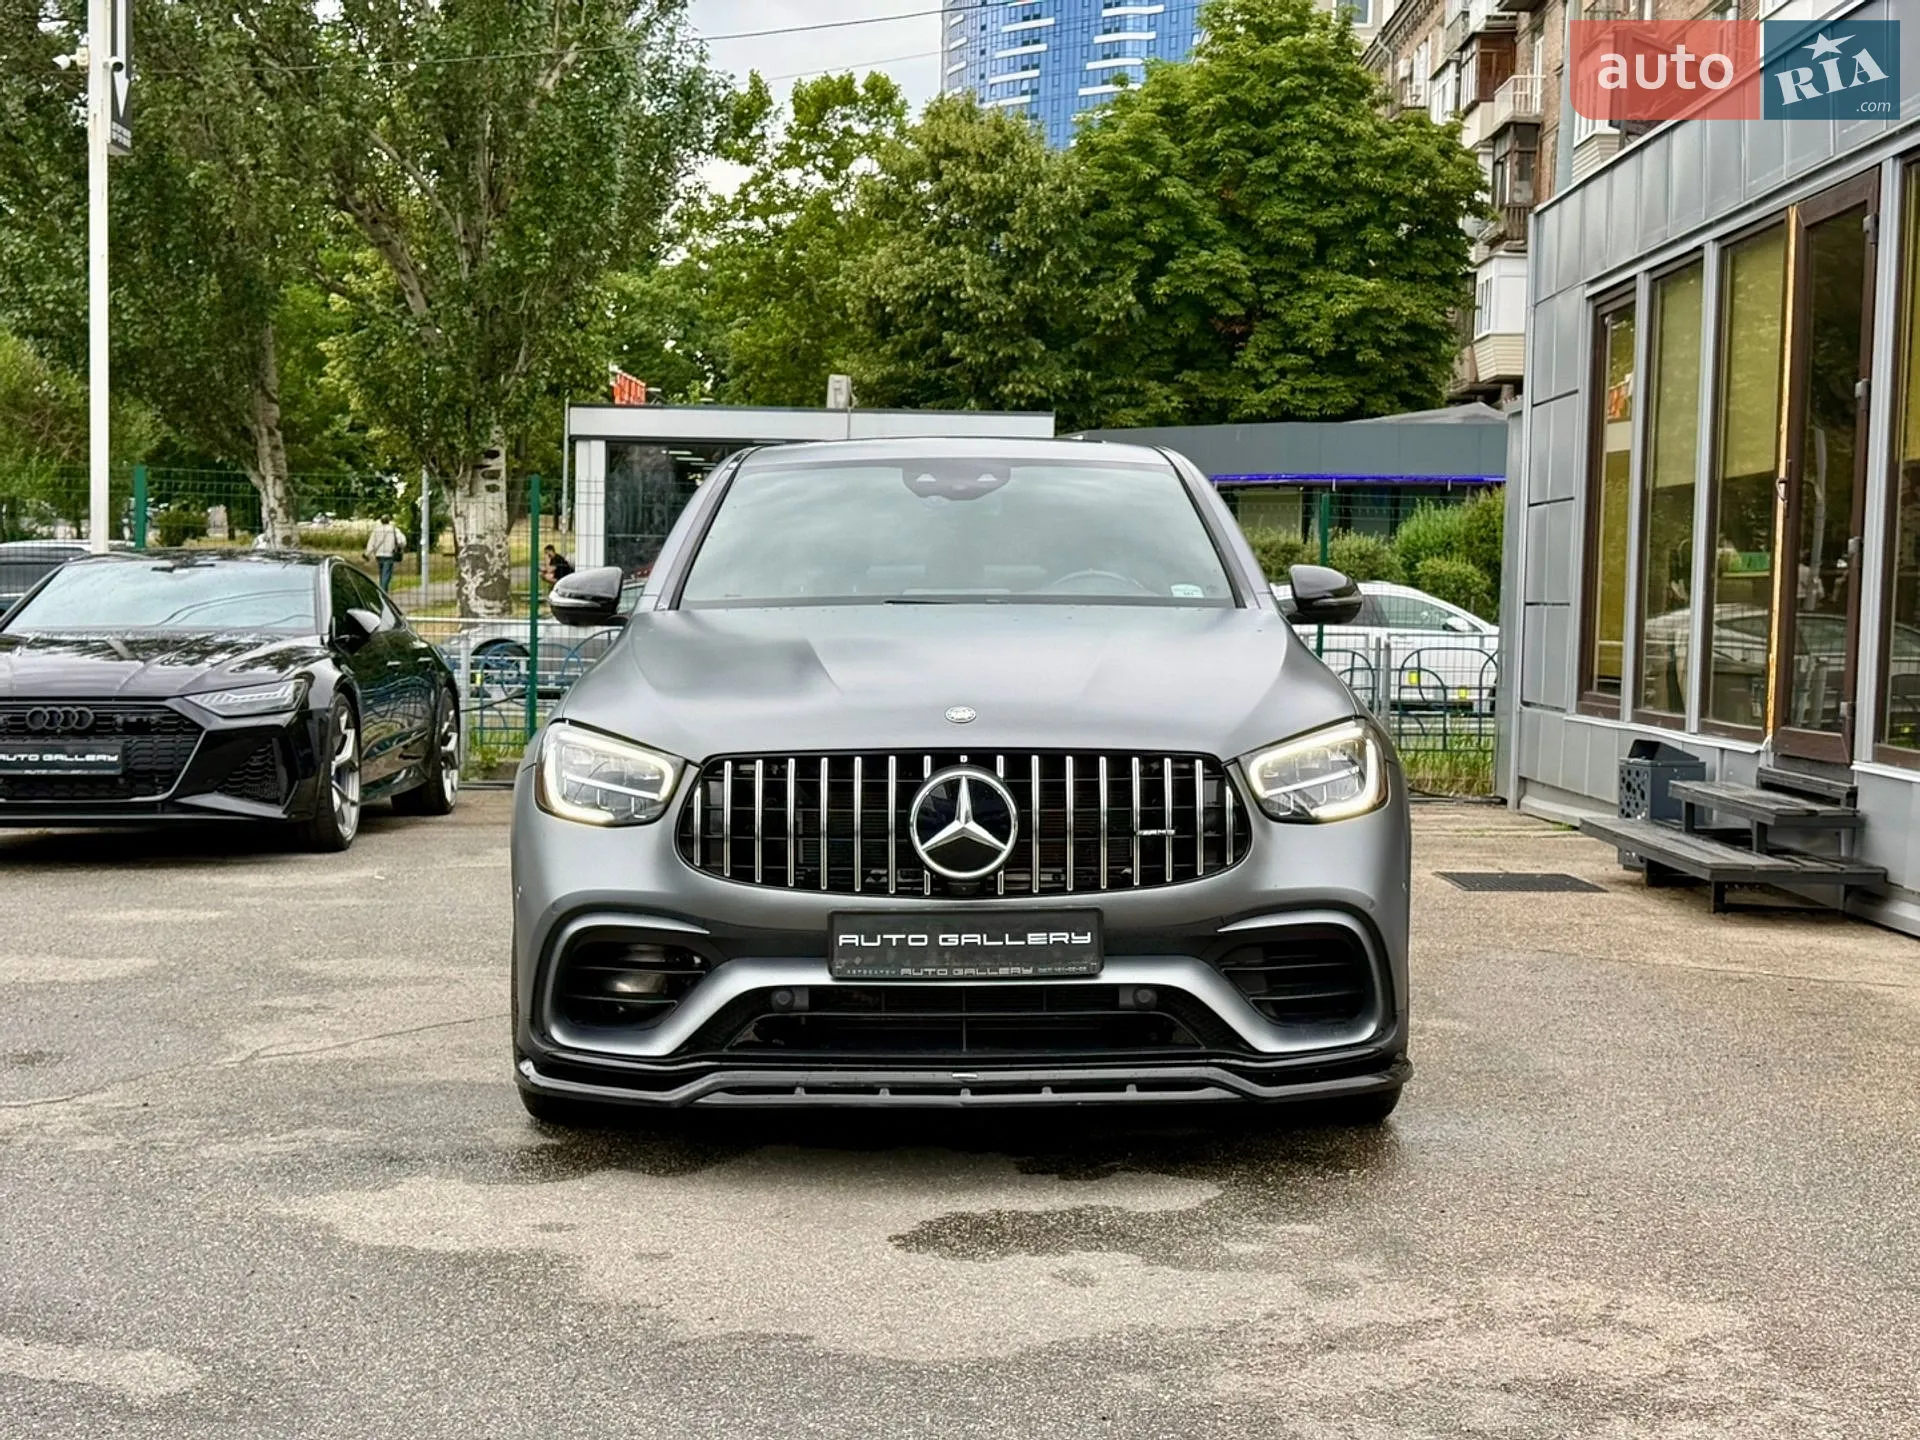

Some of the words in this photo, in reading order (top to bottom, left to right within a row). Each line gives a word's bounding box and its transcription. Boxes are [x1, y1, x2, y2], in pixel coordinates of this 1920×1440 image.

[839, 934, 928, 947] AUTO
[938, 932, 1091, 946] GALLERY
[900, 968, 948, 976] AUTO
[952, 967, 1033, 976] GALLERY
